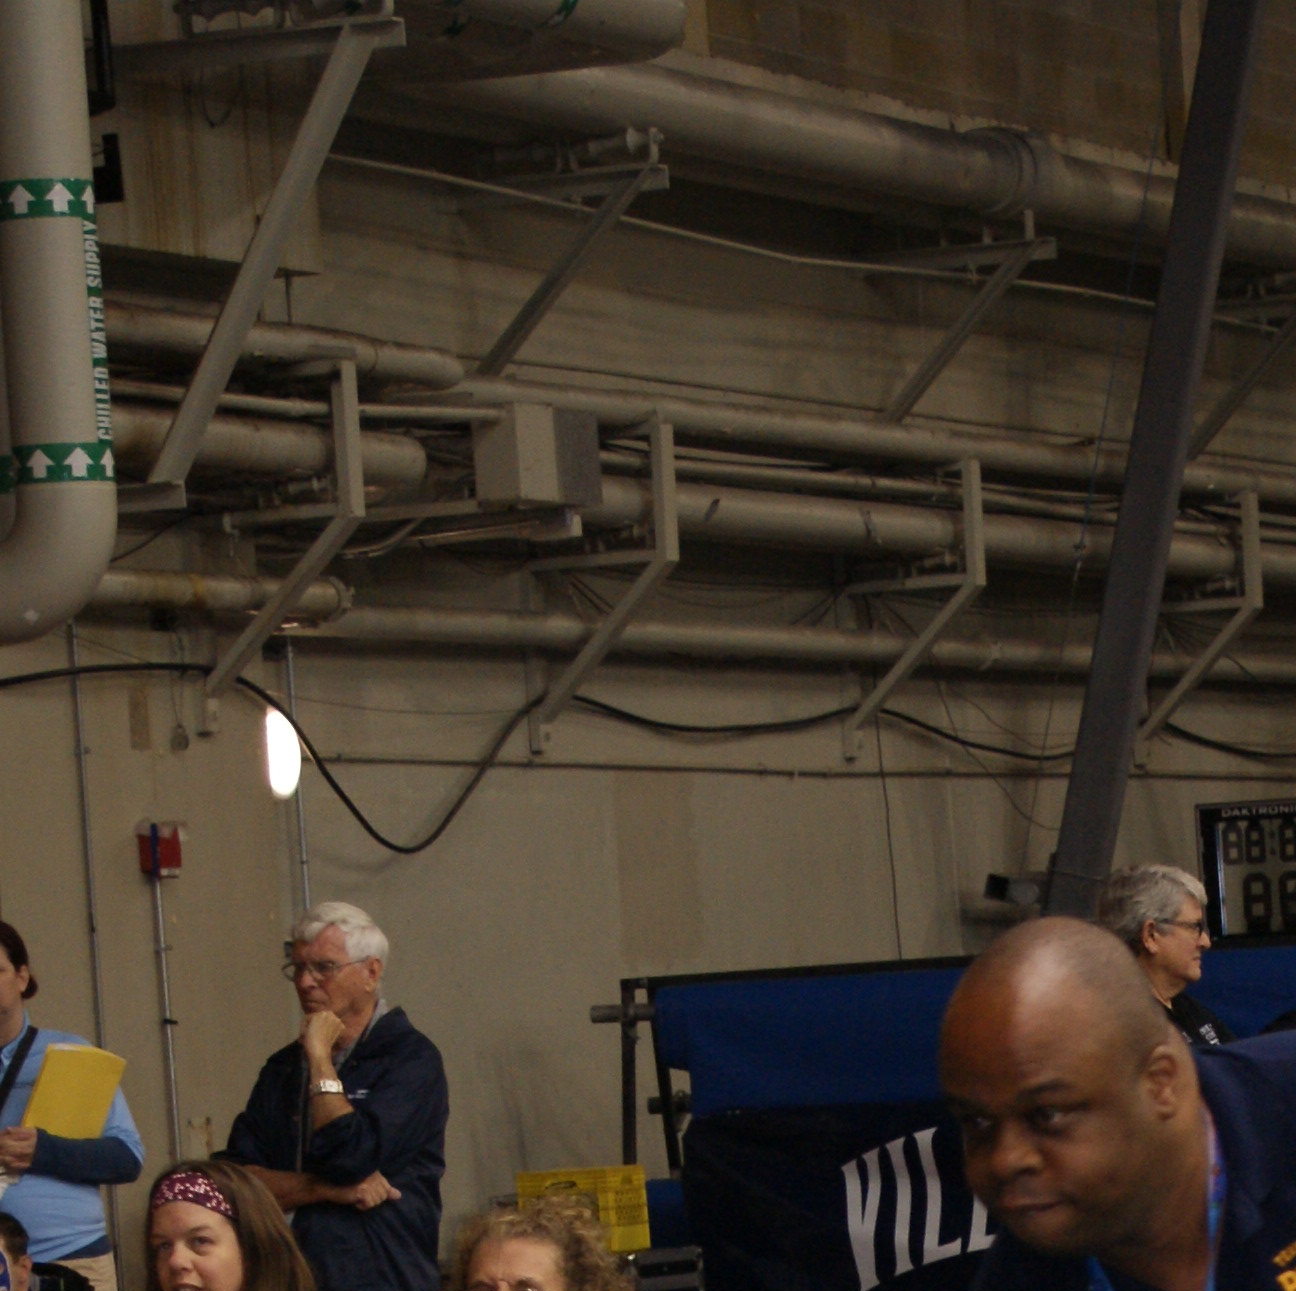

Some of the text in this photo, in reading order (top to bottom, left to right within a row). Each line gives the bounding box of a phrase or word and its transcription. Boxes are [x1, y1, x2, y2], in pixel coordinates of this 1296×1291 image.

[82, 220, 113, 440] CHILLED WATER SUPPLY
